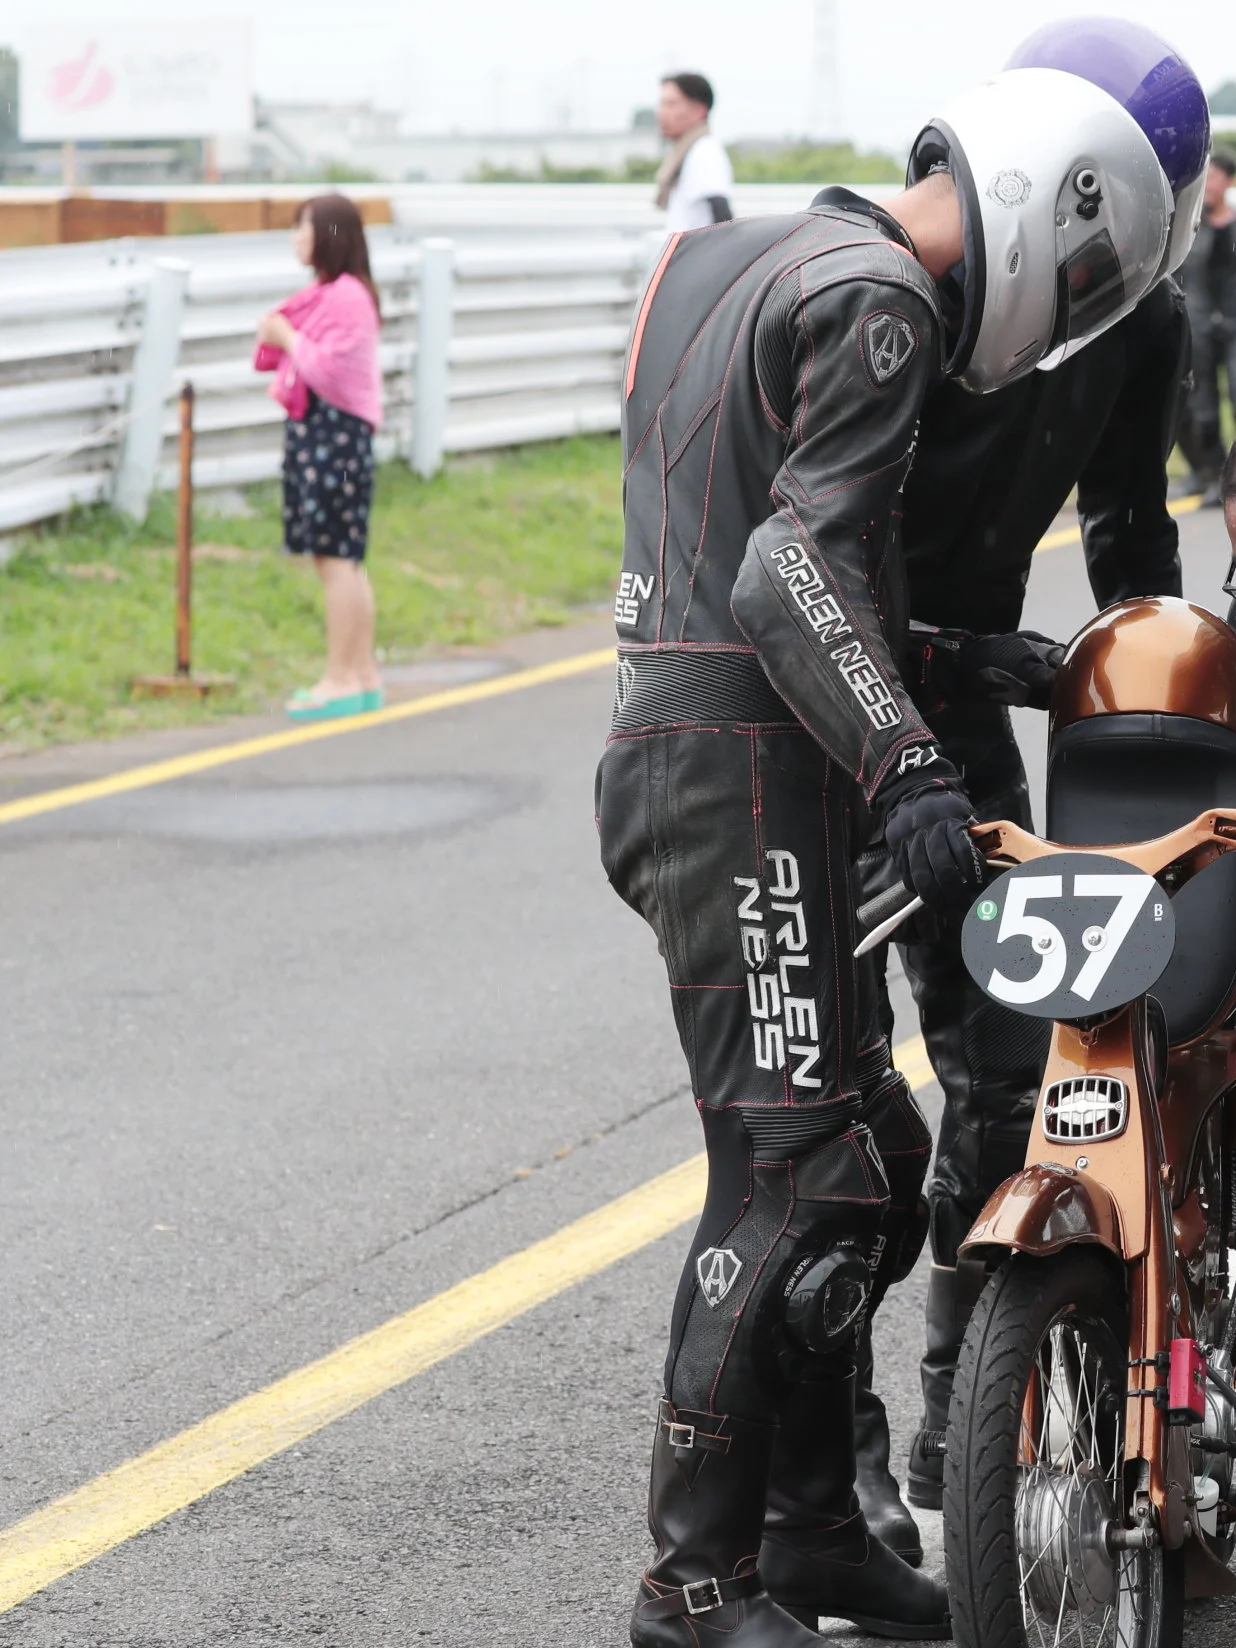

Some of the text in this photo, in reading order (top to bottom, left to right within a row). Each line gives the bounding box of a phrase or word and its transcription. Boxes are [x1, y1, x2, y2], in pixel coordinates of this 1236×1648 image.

[617, 571, 655, 601] EN
[770, 542, 902, 731] ARLEN NESS
[733, 875, 787, 1071] NESS
[766, 849, 822, 1088] ARLEN
[986, 873, 1157, 1005] 57
[1154, 903, 1164, 917] B
